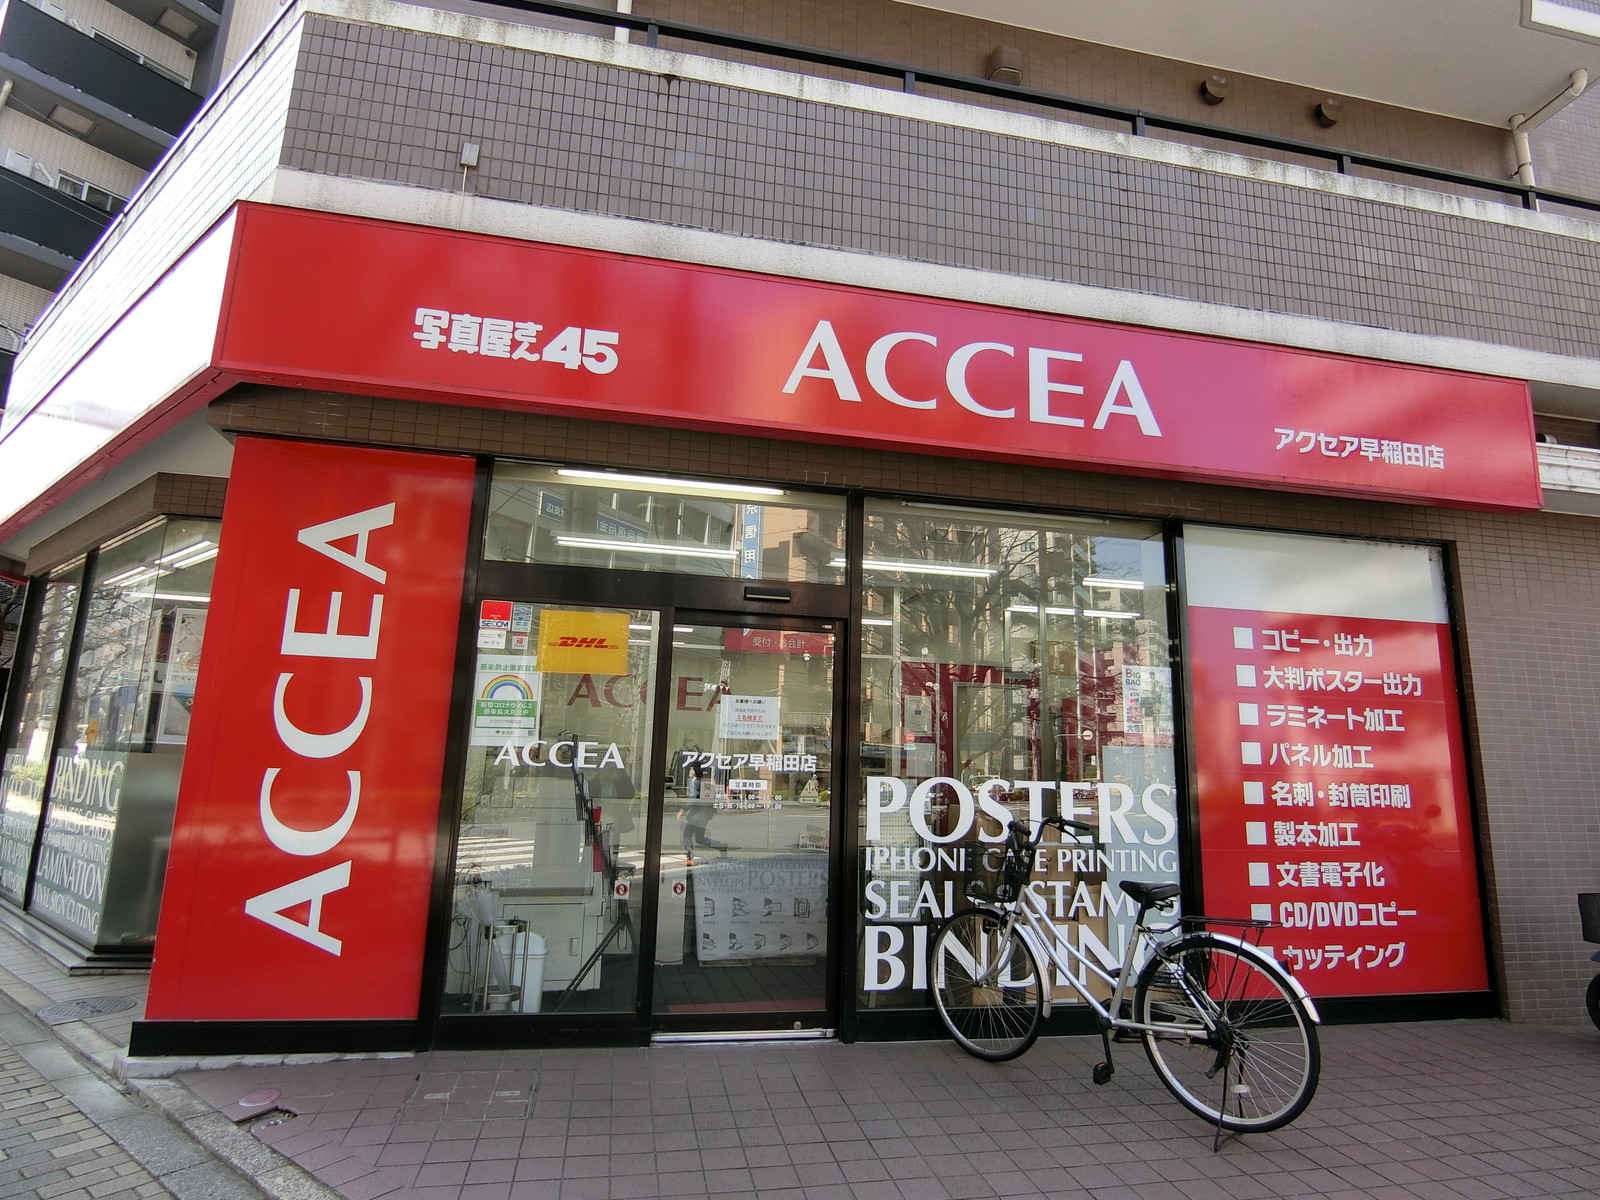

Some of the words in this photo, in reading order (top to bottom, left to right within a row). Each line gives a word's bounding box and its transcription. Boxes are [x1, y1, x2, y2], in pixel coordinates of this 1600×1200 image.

[781, 319, 1163, 437] ACCEA
[1274, 427, 1445, 469] アクセア早稲田店
[481, 619, 509, 628] SECOM
[558, 636, 609, 649] DHL
[1261, 629, 1374, 658] コピー・出力
[567, 673, 731, 712] ACEA
[1263, 666, 1422, 696] 大判ポスター出力
[244, 502, 396, 957] ACCEA
[1266, 703, 1406, 732] ラミネート加工
[493, 739, 625, 769] ACCEA
[682, 751, 817, 772] アクセア早稲田店
[1269, 742, 1375, 769] パネル加工
[50, 755, 124, 813] BINDING
[1270, 780, 1412, 809] 名刺・封筒印刷
[865, 775, 1177, 846] POSTERS
[1273, 820, 1361, 847] 製本加工
[36, 845, 107, 905] LAMINATION
[1057, 848, 1177, 873] PRINTING
[1275, 860, 1386, 888] 文書電子化
[1020, 880, 1179, 919] STAMS
[66, 901, 99, 935] CUTTING
[1279, 901, 1417, 930] CD/DVDコピー
[1281, 941, 1407, 970] カッティング
